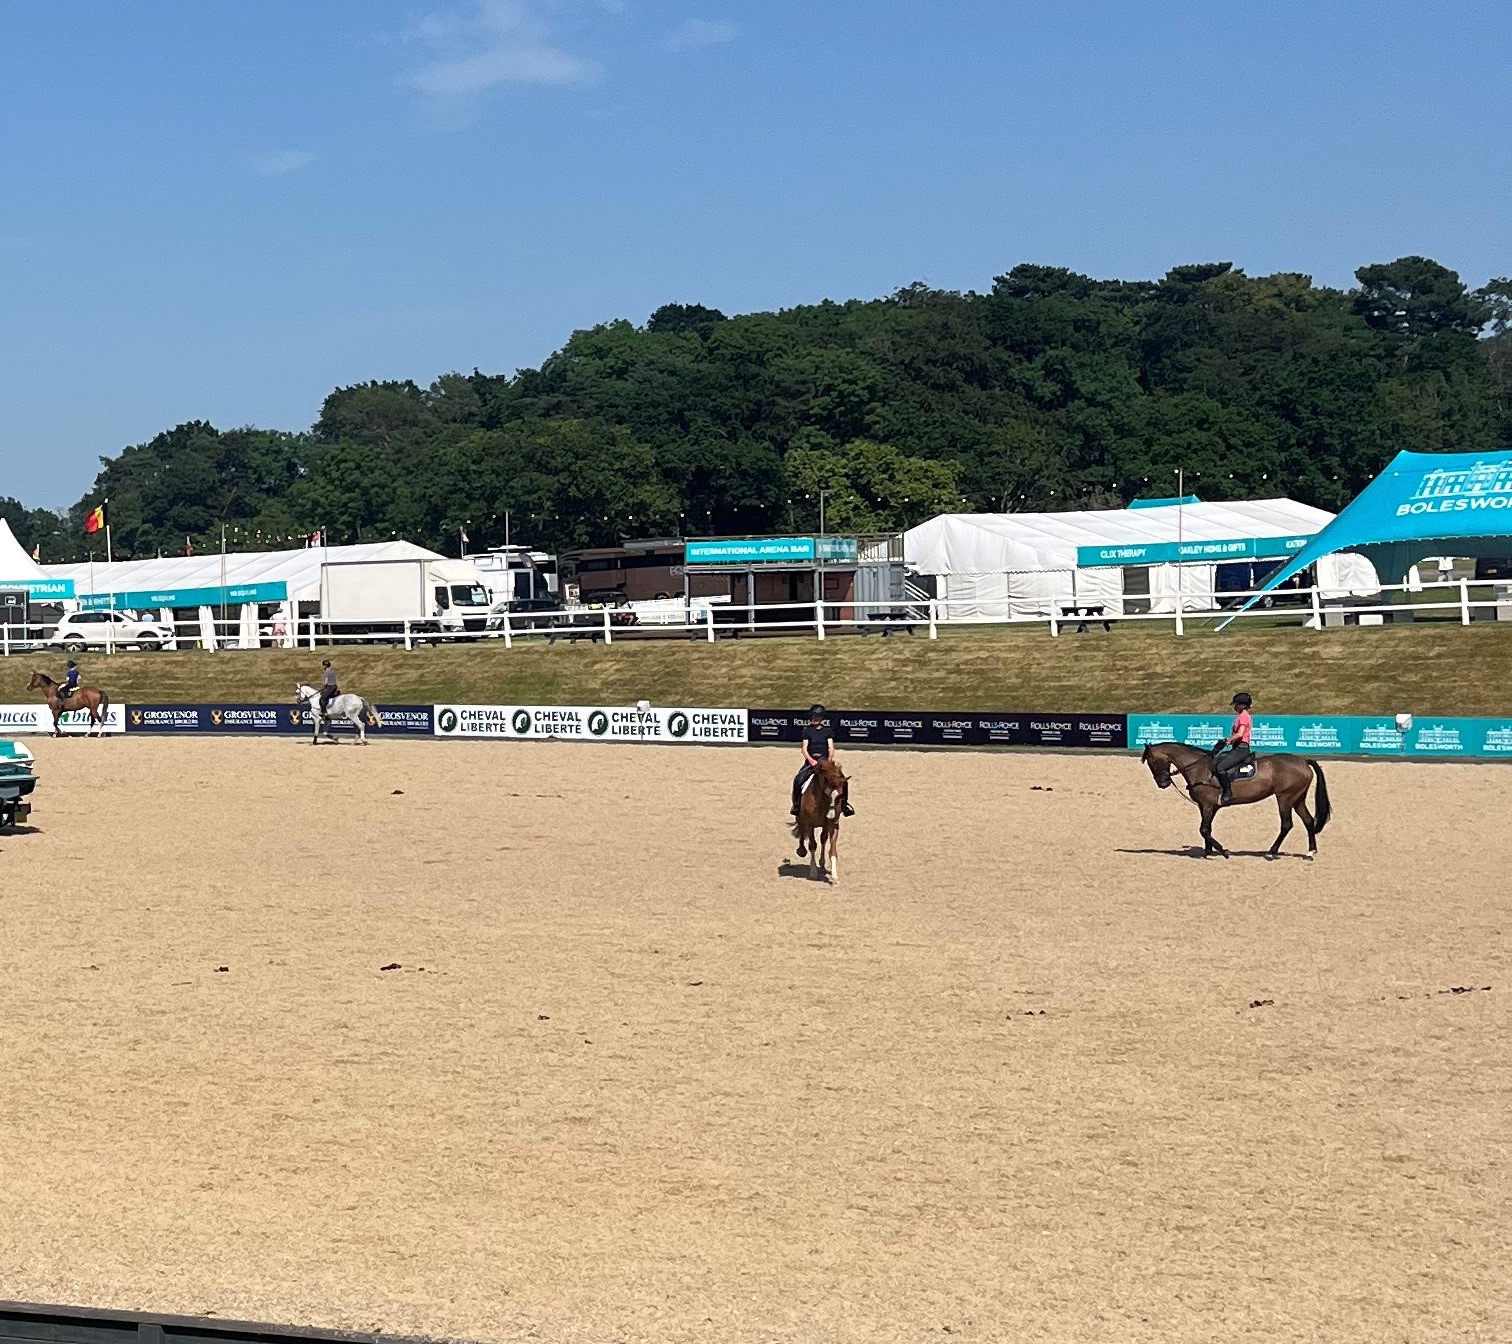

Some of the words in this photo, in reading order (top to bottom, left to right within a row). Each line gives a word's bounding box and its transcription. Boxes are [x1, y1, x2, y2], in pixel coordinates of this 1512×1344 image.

[1396, 496, 1512, 516] BOLESWO
[691, 546, 758, 556] INTERNATIONAL
[760, 545, 789, 554] ARENA
[791, 544, 809, 552] BAR
[379, 712, 428, 720] GROSVENOR
[460, 710, 506, 720] CHEVAL
[534, 712, 582, 722] CHEVAL
[612, 712, 660, 723] CHEVAL
[692, 714, 744, 725] CHEVAL
